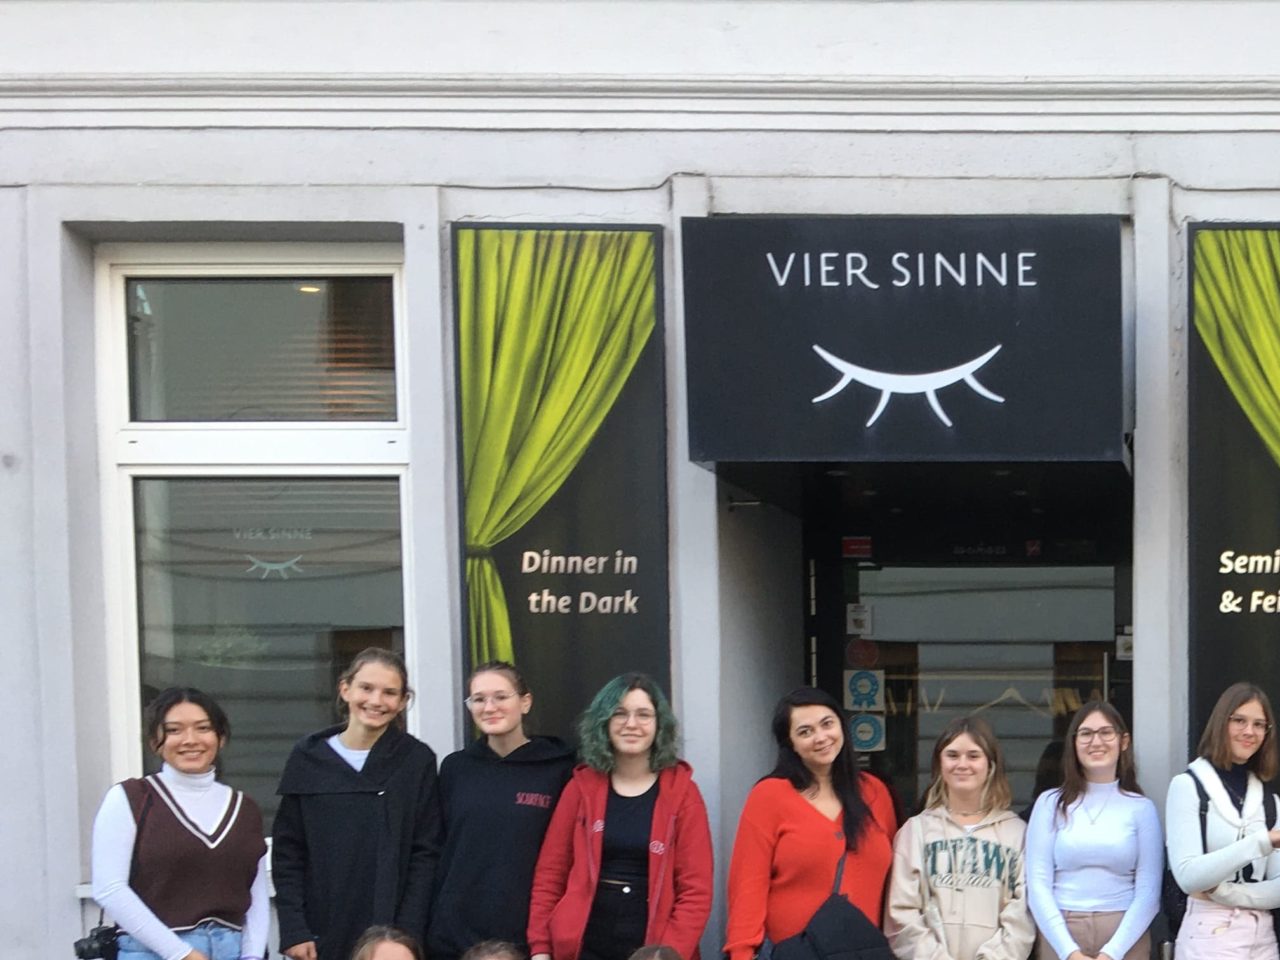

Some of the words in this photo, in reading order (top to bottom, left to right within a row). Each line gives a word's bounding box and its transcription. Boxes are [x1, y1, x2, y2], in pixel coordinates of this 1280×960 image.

[766, 252, 880, 289] VIER
[891, 252, 1037, 287] SINNE
[521, 549, 609, 574] Dinner
[614, 549, 638, 574] in
[527, 588, 572, 614] the
[579, 589, 640, 614] Dark
[1219, 590, 1243, 613] &
